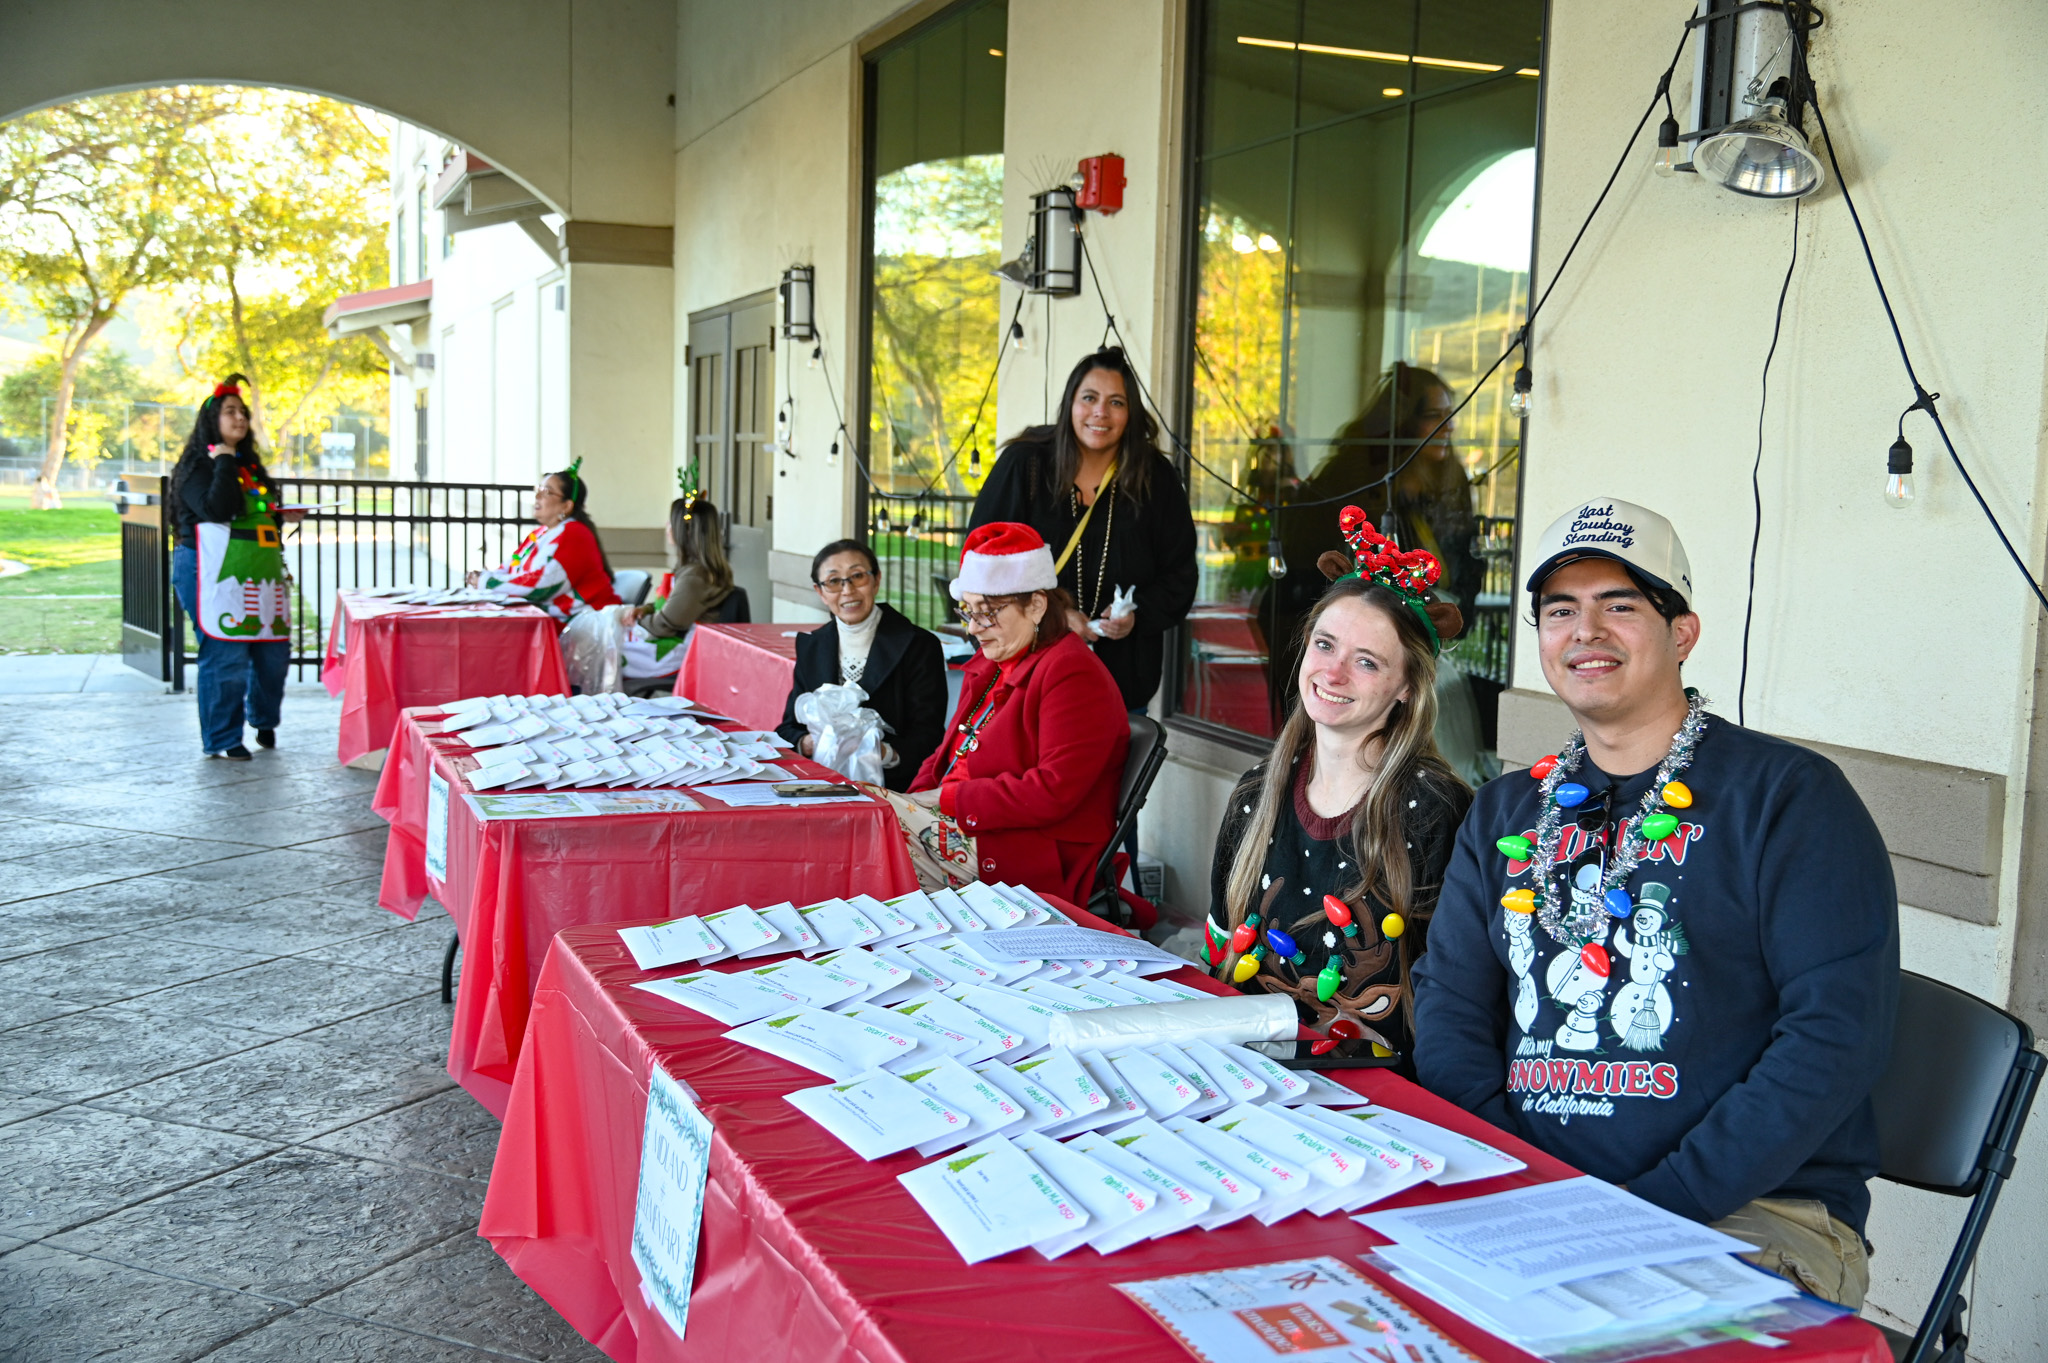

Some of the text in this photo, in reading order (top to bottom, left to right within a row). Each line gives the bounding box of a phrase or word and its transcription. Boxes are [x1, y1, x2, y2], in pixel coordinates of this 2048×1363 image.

[1578, 504, 1614, 519] Last
[1570, 518, 1635, 536] Cowboy
[1562, 531, 1635, 549] Standing
[1515, 1035, 1554, 1058] With my
[1506, 1059, 1679, 1099] SNOWMIES
[1522, 1092, 1615, 1126] in California
